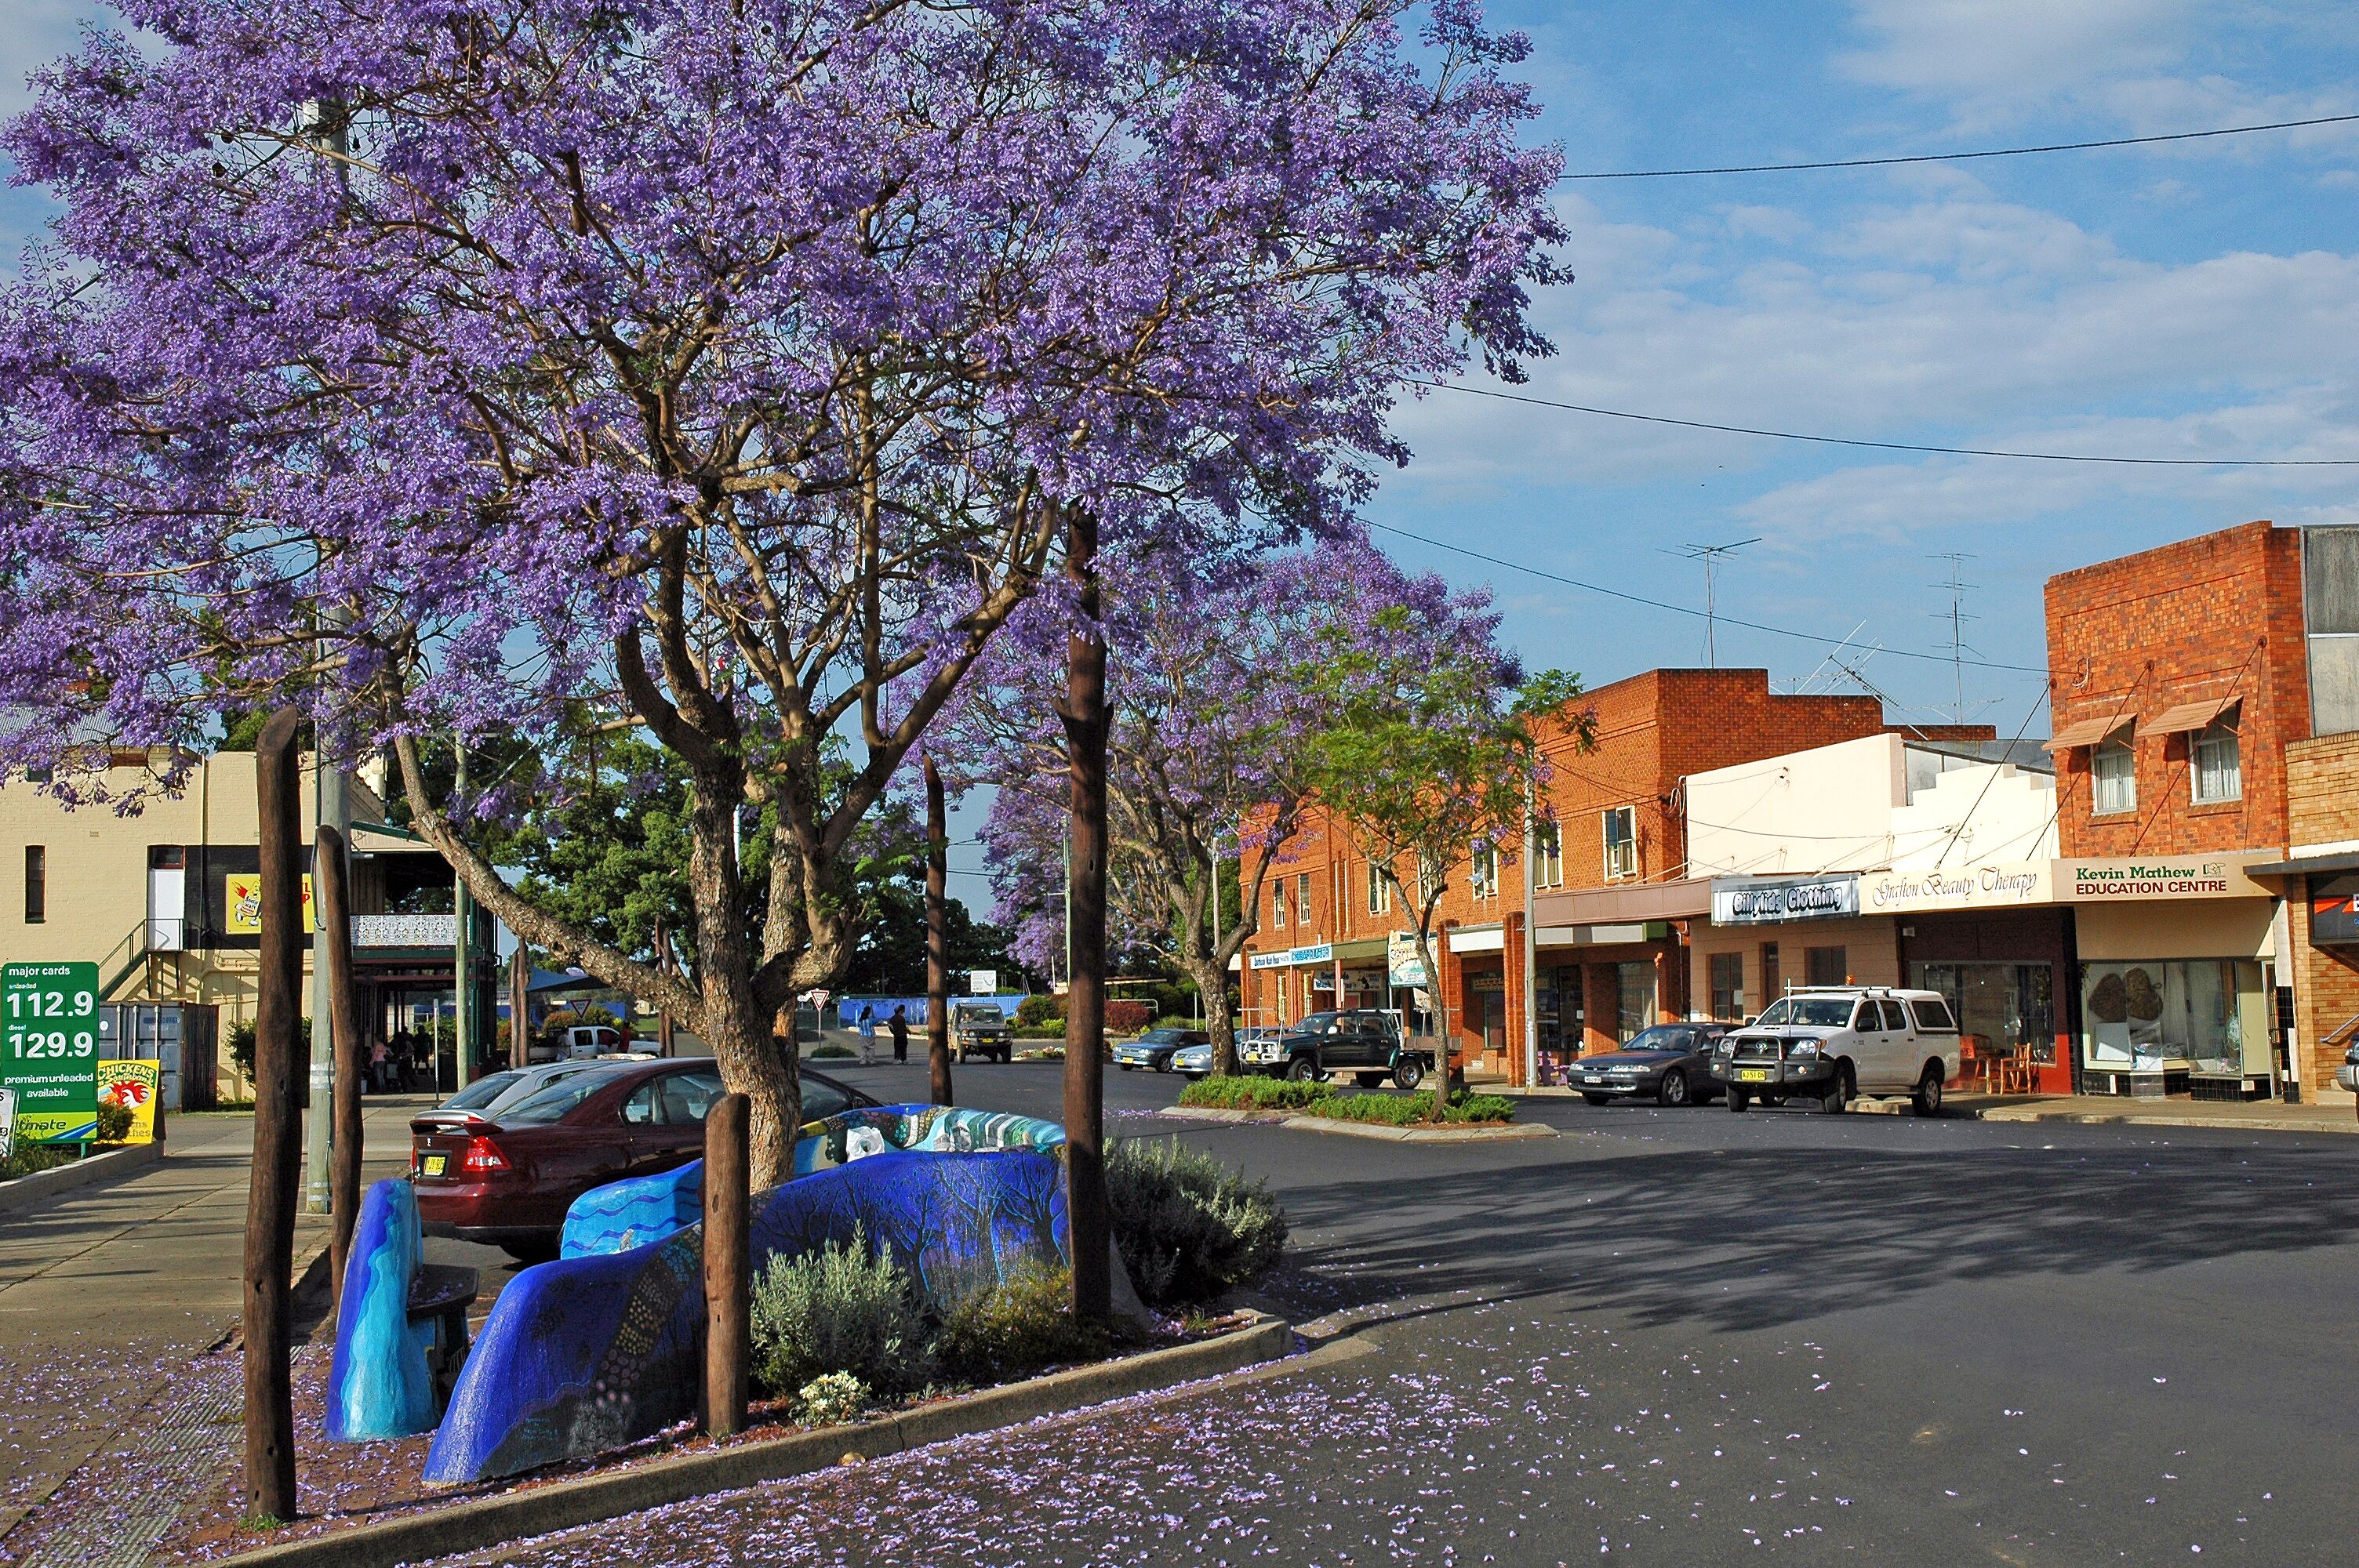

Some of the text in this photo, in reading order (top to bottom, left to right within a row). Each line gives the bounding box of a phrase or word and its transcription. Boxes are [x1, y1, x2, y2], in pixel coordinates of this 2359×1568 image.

[2075, 866, 2196, 880] Kevin Mathew
[1873, 866, 2037, 906] Grafton Beauty Therapy
[2076, 880, 2227, 895] EDUCATION CENTRE
[1787, 885, 1843, 912] Clothing
[9, 965, 71, 978] major cards
[6, 990, 93, 1018] 112.9
[9, 1032, 93, 1058] 129.9
[5, 1073, 93, 1086] premium unleaded
[97, 1063, 155, 1080] CHICKENS
[26, 1087, 69, 1098] available
